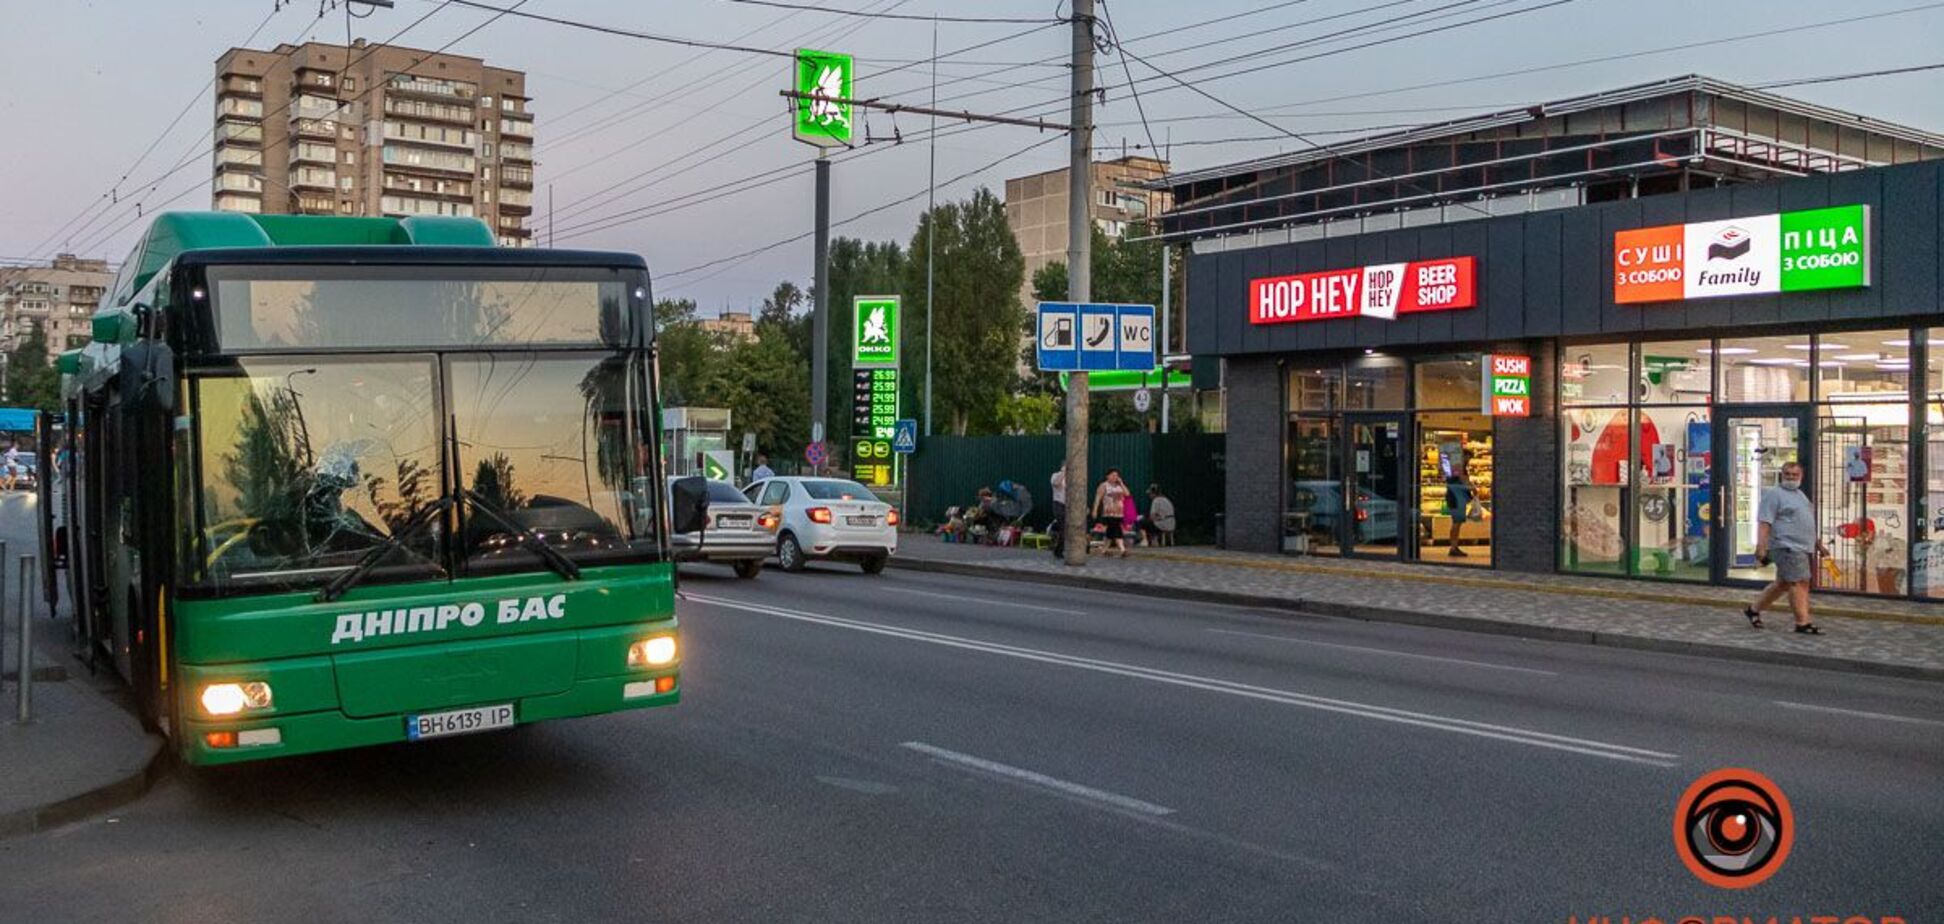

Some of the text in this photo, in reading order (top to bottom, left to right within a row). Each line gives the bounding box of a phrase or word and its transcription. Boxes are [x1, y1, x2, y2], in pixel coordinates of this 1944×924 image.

[1784, 225, 1859, 251] ПІЦА
[1618, 243, 1682, 267] СУШІ
[1796, 252, 1859, 270] СОБОЮ
[1368, 270, 1394, 289] HOP
[1418, 264, 1457, 286] BEER
[1629, 267, 1682, 284] СОБОЮ
[1698, 267, 1761, 286] Family
[1259, 273, 1359, 319] HOP HEY
[1368, 289, 1393, 308] HEY
[1418, 285, 1457, 306] SHOP
[1123, 325, 1150, 342] WC
[1494, 357, 1527, 374] SUSHI
[1494, 378, 1527, 394] PIZZA
[1497, 398, 1524, 413] WOK
[1644, 498, 1664, 514] 45
[331, 594, 566, 645] ДНІПРО БАС
[446, 711, 483, 731] 6139
